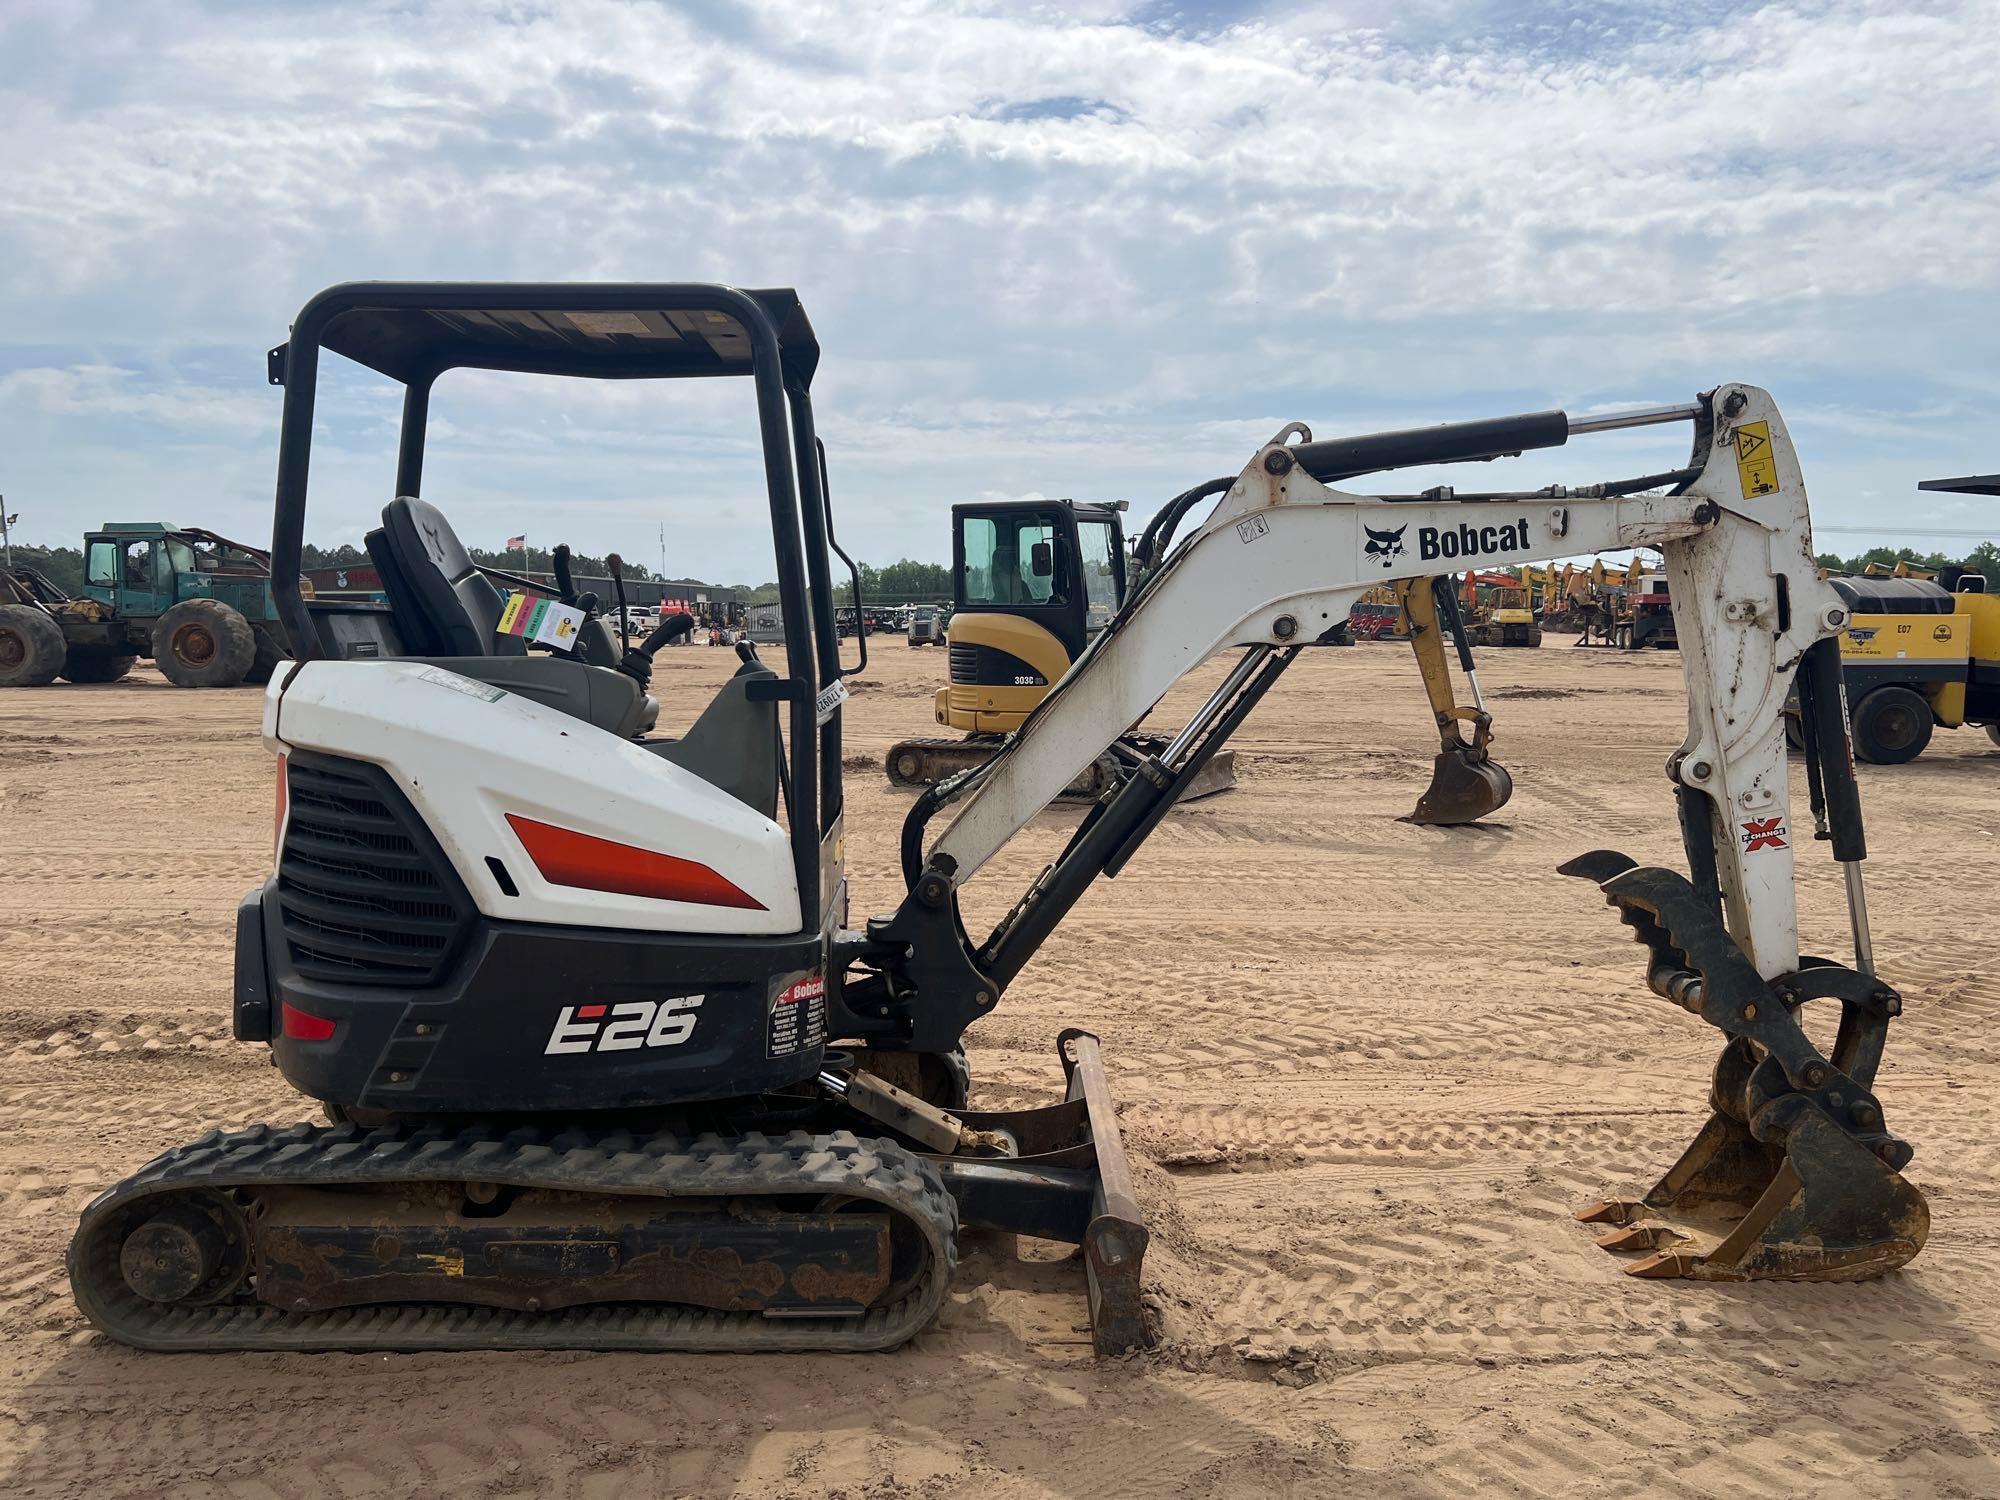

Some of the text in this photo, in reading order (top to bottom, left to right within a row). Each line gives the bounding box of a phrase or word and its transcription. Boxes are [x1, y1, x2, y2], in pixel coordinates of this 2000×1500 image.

[1418, 518, 1530, 560] Bobcat
[1898, 625, 1912, 634] E07
[794, 982, 824, 999] Bobcat
[544, 994, 706, 1054] E26
